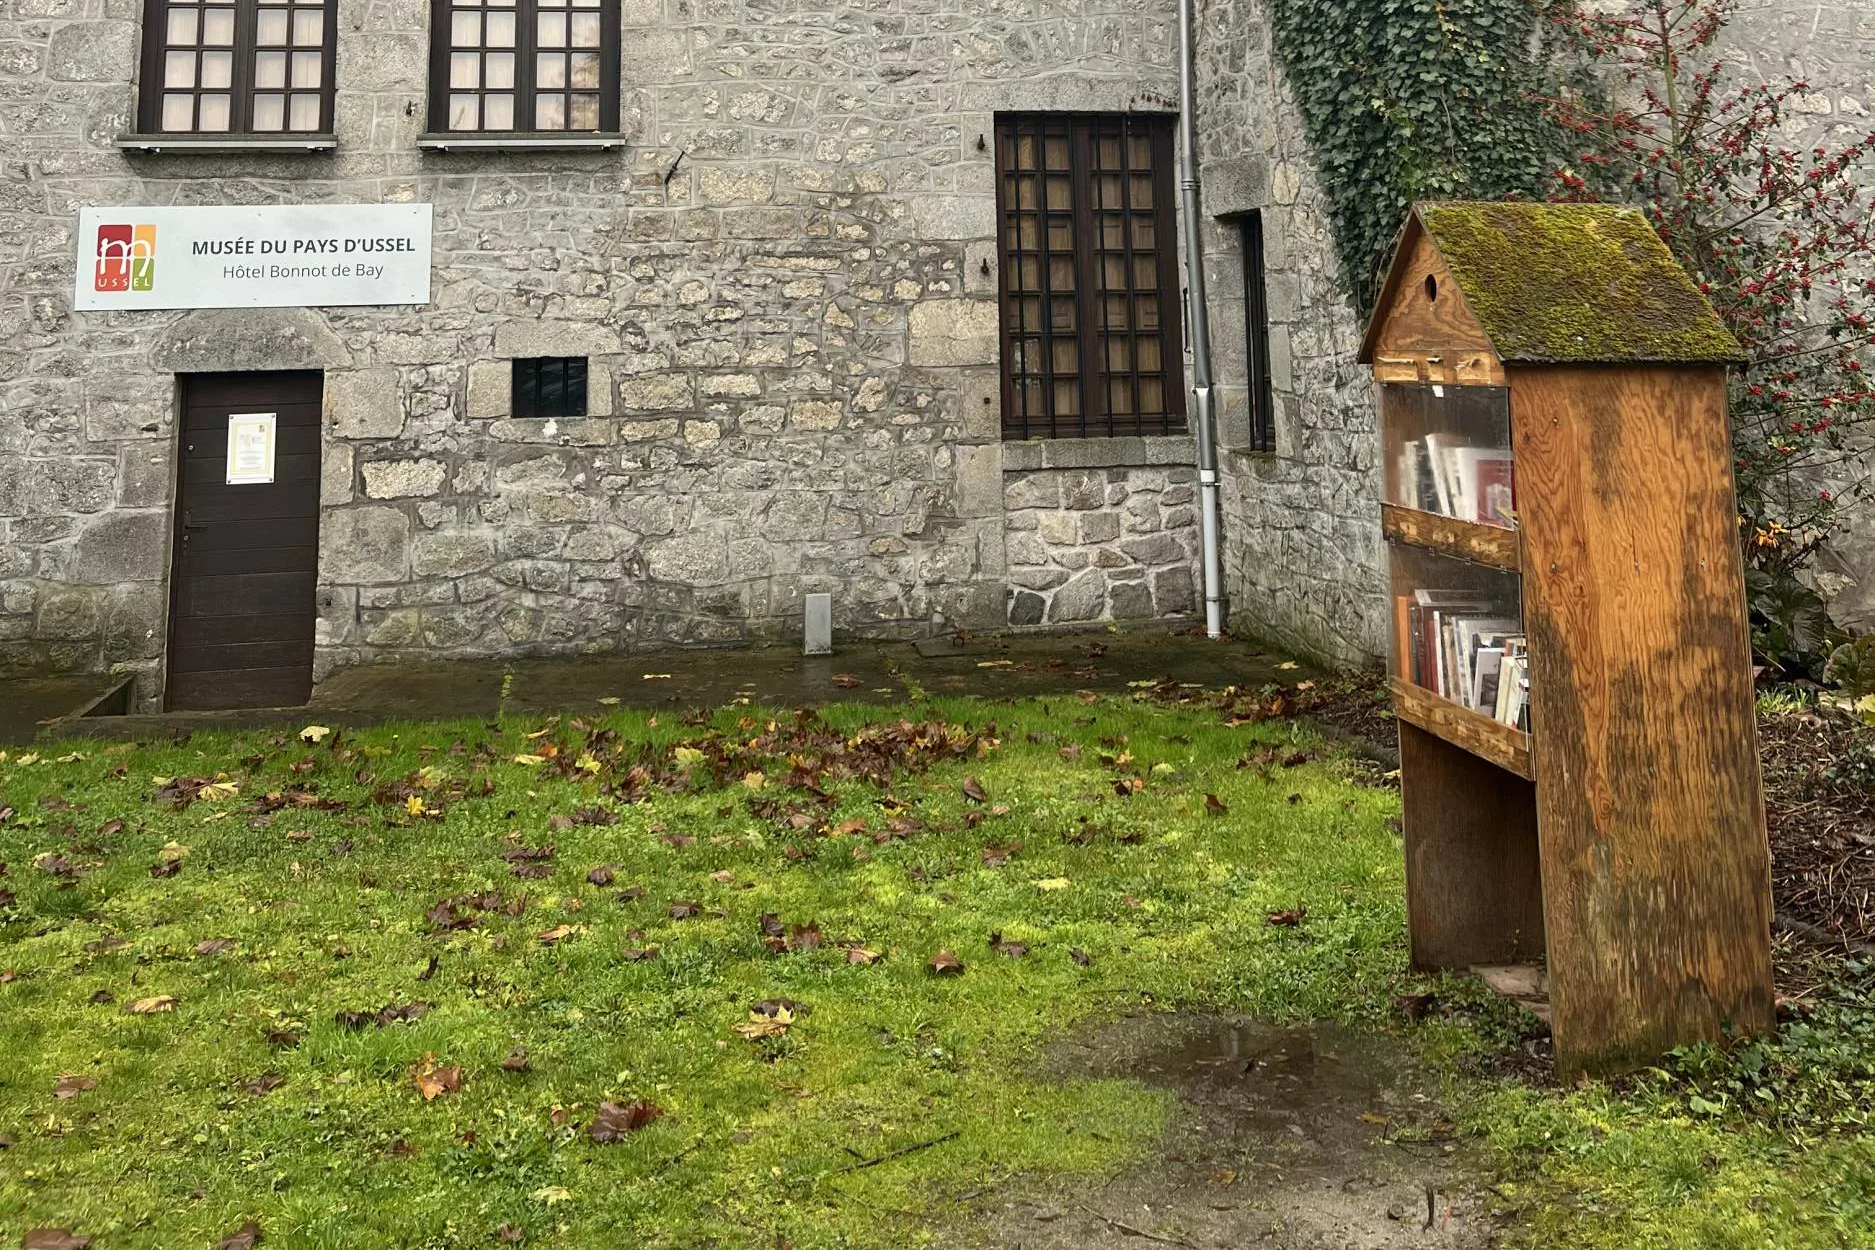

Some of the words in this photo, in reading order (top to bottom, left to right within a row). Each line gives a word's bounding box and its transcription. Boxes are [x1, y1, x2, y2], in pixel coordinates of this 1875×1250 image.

[192, 237, 255, 255] MUSÉE
[260, 240, 288, 254] DU
[293, 239, 339, 254] PAYS
[223, 264, 265, 279] Hôtel
[270, 264, 326, 278] Bonnot
[331, 263, 351, 277] de
[355, 263, 384, 280] Bay
[98, 277, 151, 288] USSEL
